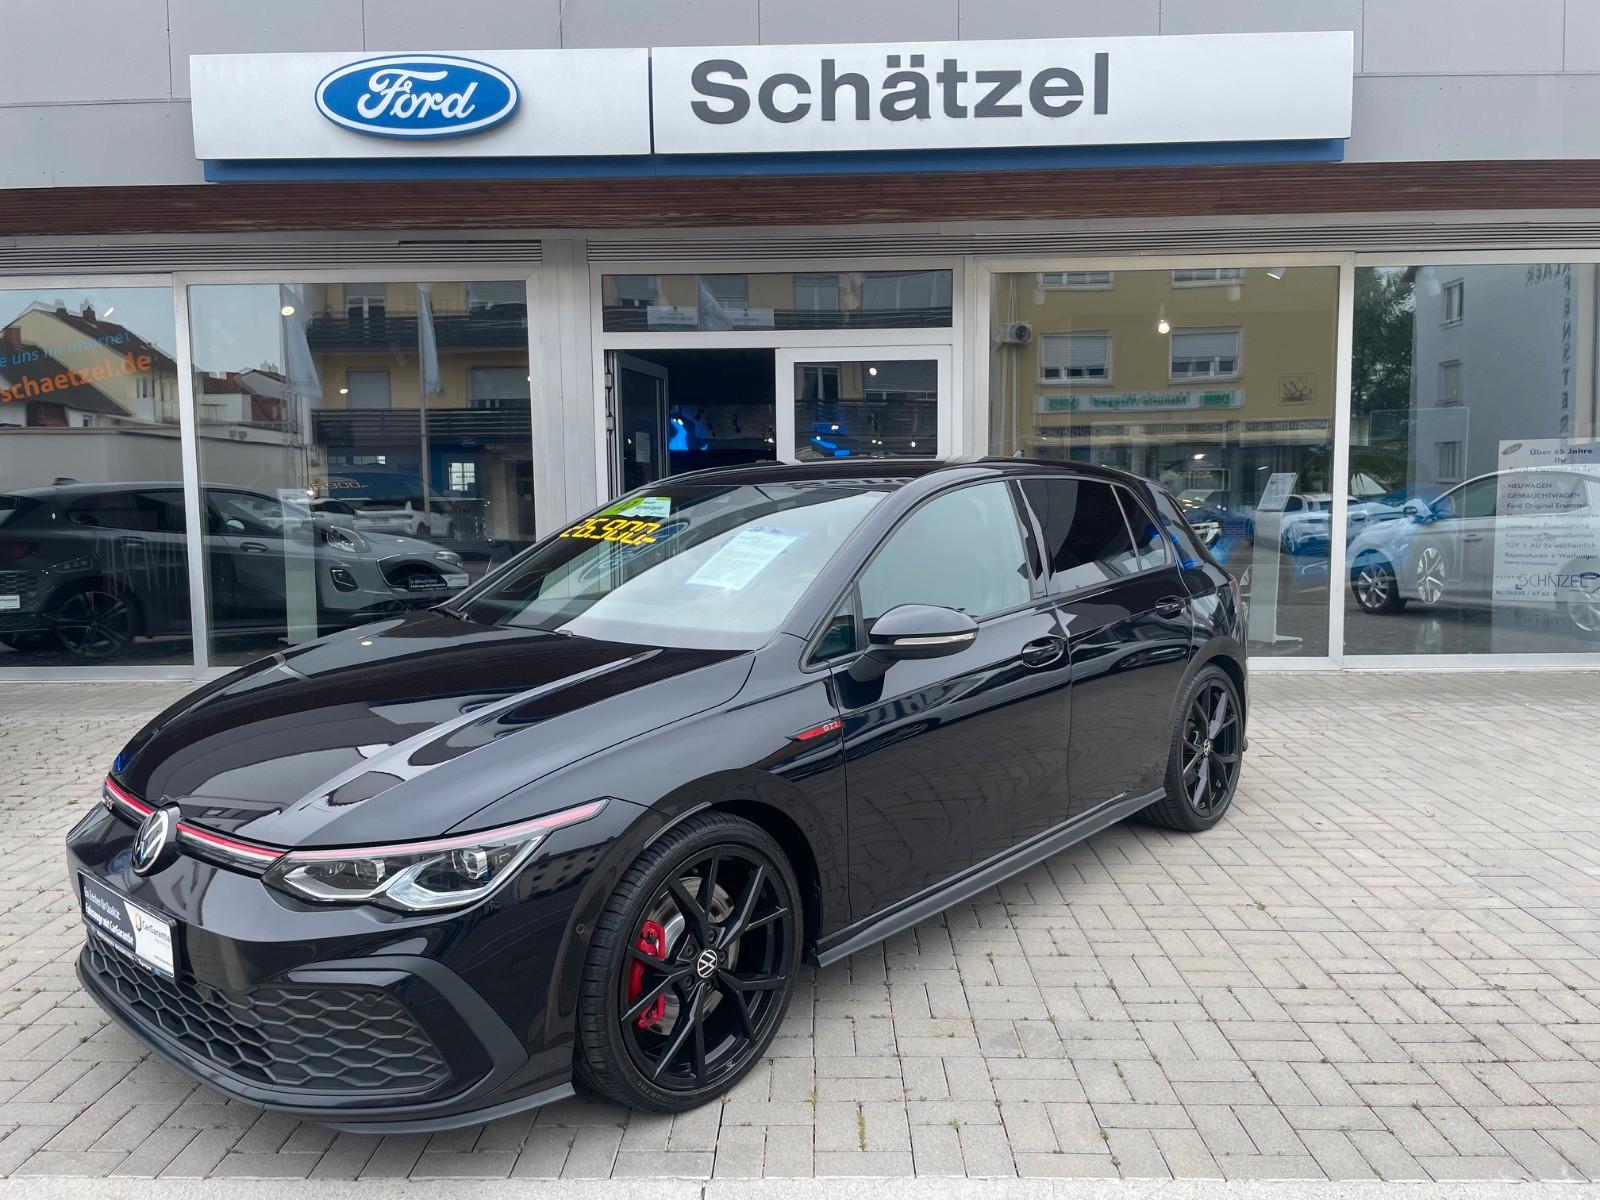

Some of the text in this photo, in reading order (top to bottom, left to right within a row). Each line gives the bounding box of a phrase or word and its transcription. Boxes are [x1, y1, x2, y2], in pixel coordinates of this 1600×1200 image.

[356, 68, 478, 120] Ford
[690, 53, 1109, 125] Schätzel
[12, 351, 39, 365] uns
[1530, 447, 1551, 456] Über
[1567, 447, 1593, 455] Jahre
[1525, 502, 1553, 510] Original
